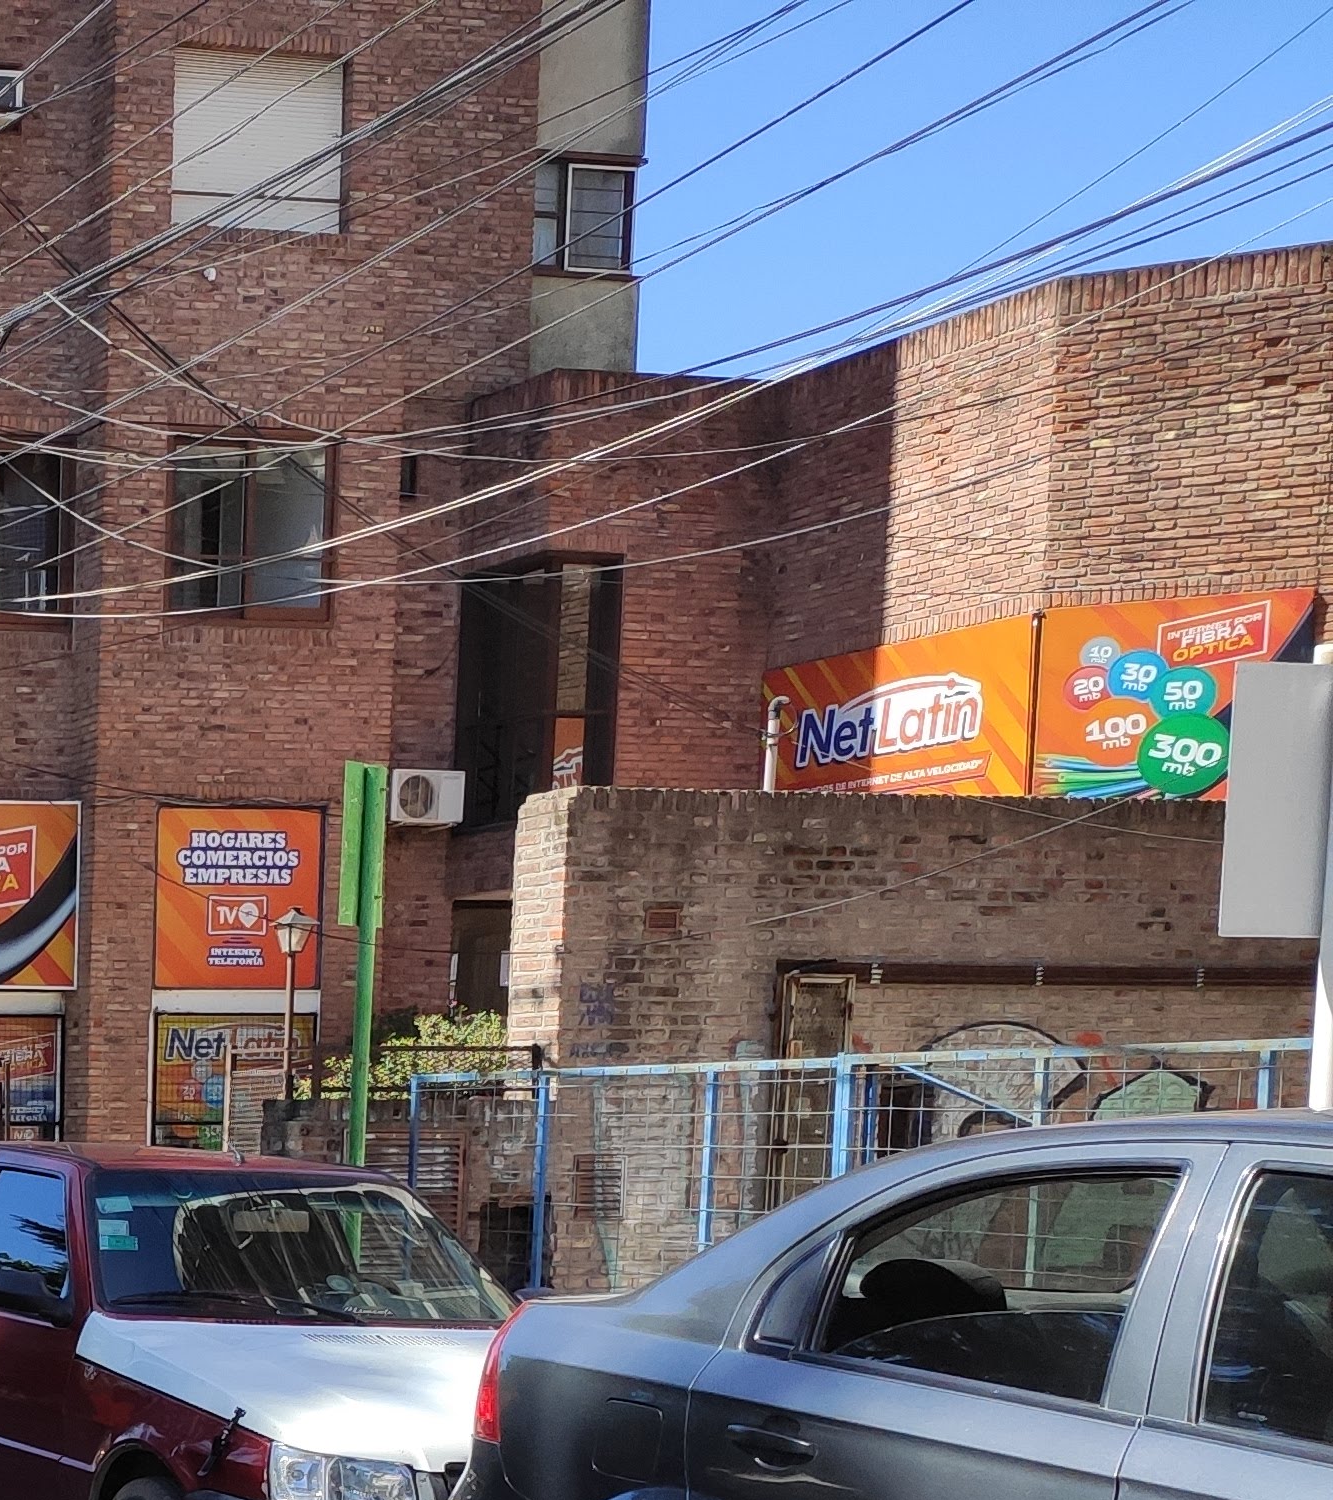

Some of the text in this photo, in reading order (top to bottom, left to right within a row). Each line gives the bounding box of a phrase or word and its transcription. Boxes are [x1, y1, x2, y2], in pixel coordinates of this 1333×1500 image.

[1167, 612, 1263, 641] INTERNET POR
[1180, 624, 1248, 648] FIBRA
[1088, 646, 1113, 658] 10
[1090, 656, 1107, 664] mb
[1120, 662, 1158, 684] 30
[1073, 675, 1105, 696] 20
[1122, 680, 1148, 692] mb
[1163, 680, 1203, 701] 50
[1078, 691, 1101, 703] mb
[1168, 699, 1196, 711] mb
[1085, 713, 1147, 742] 100
[1102, 736, 1131, 750] mb
[1148, 733, 1223, 768] 300
[903, 769, 925, 780] ALTA
[1161, 760, 1196, 777] mb
[191, 832, 286, 848] HOGARES
[177, 850, 299, 866] COMERCIOS
[184, 868, 291, 884] EMPRESAS
[216, 906, 238, 925] TV
